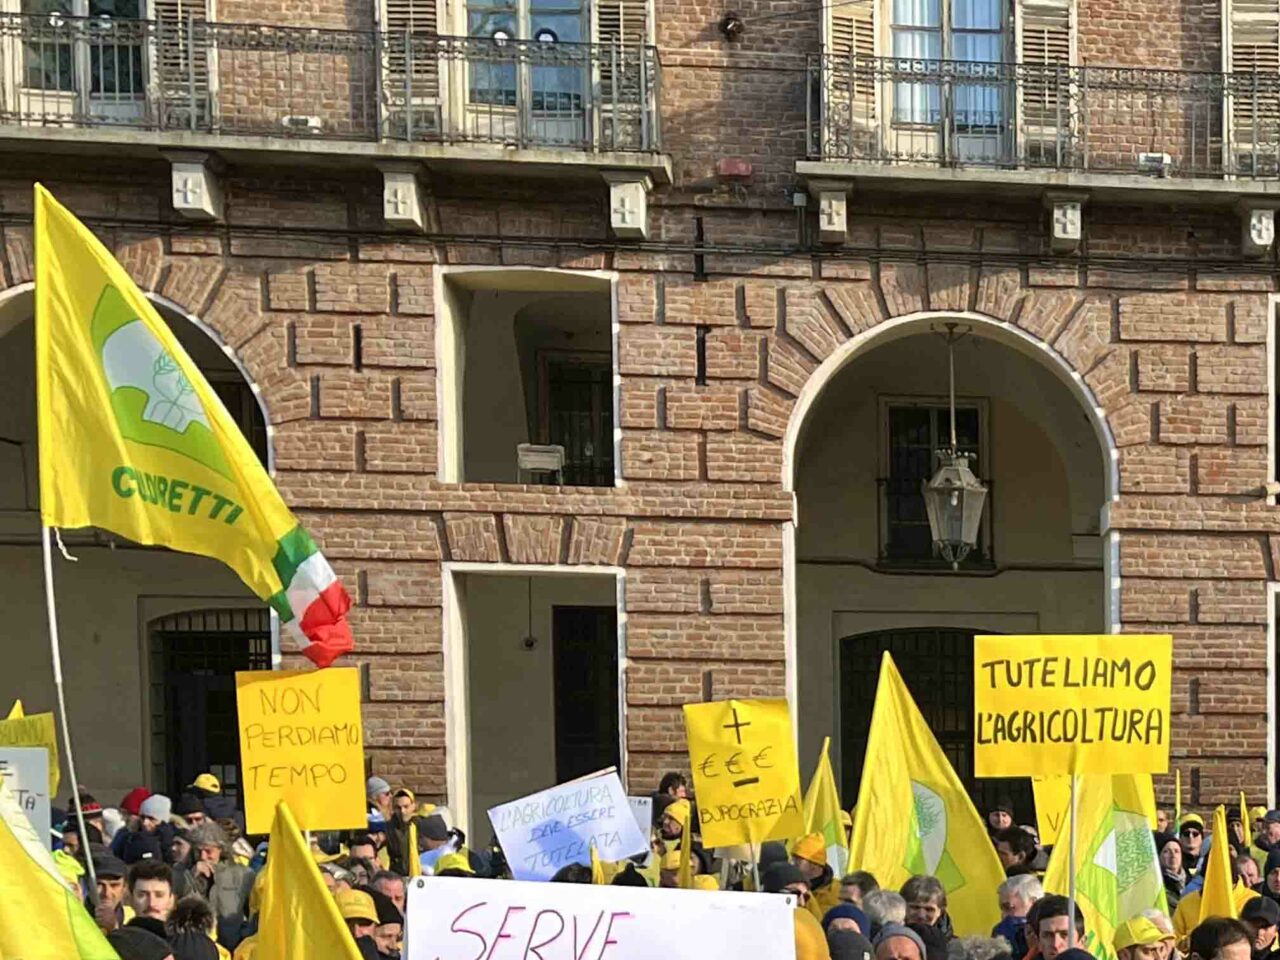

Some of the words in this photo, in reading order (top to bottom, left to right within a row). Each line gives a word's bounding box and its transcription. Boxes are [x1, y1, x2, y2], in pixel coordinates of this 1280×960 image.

[981, 656, 1157, 691] TUTELIAMO
[259, 683, 323, 715] NON
[245, 722, 359, 750] PERDIAMO
[977, 707, 1163, 744] L'AGRICOLTURA
[249, 763, 347, 790] TEMPO
[500, 784, 614, 832] L'AGRICOLTURA
